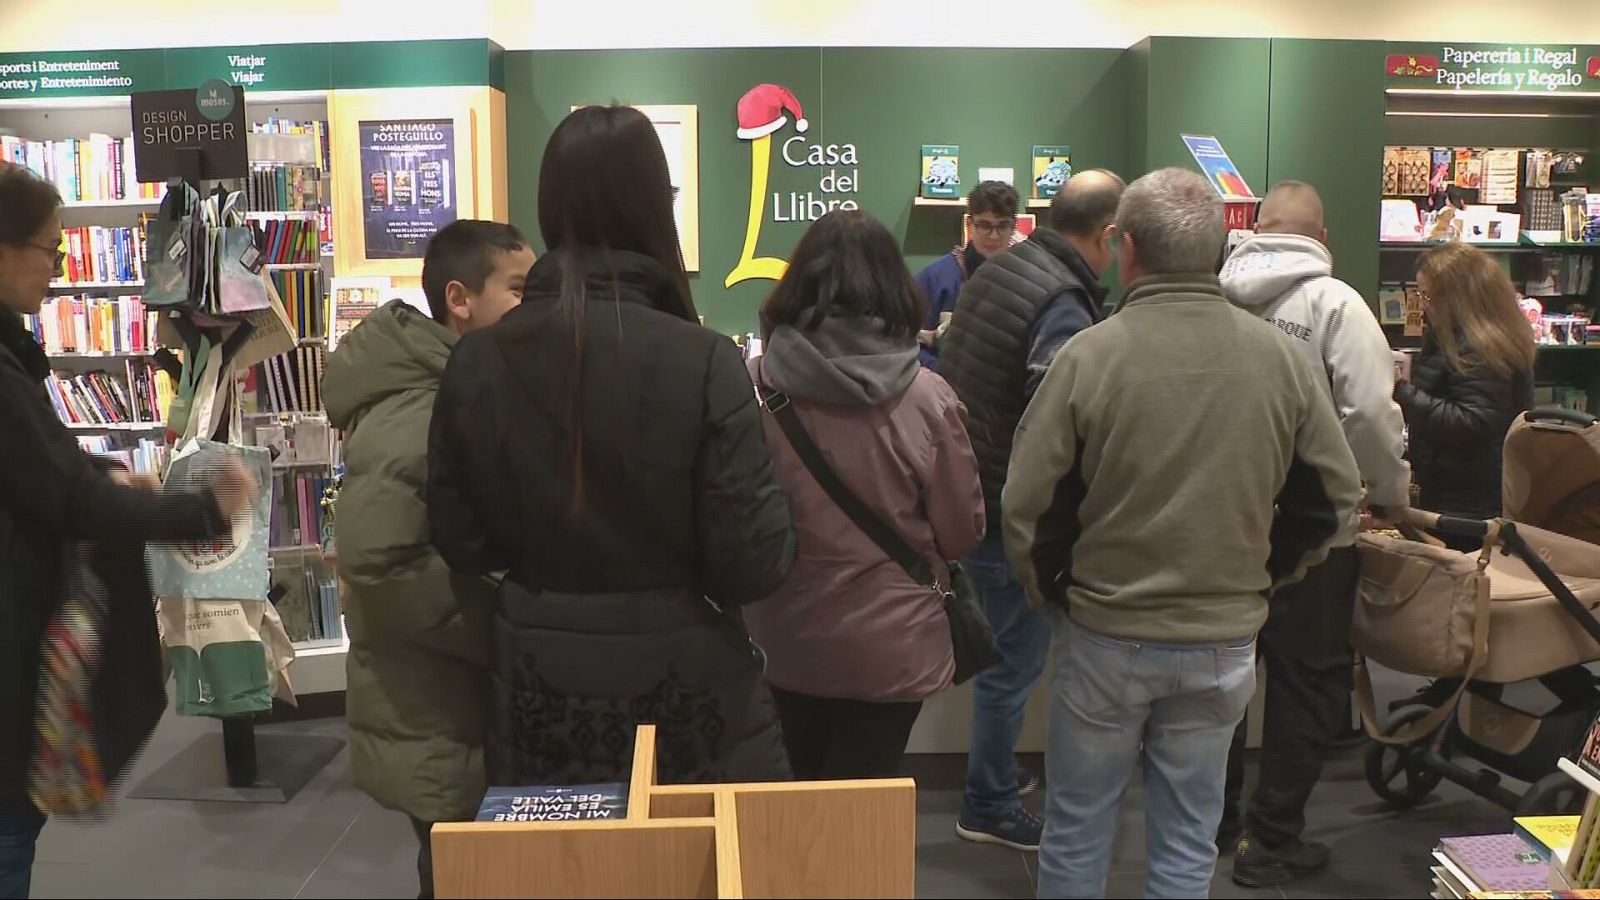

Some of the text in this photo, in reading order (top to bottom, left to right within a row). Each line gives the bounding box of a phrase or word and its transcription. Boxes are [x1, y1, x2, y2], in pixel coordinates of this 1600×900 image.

[227, 54, 267, 69] Viatjar
[1533, 47, 1577, 69] Regal
[38, 60, 120, 73] Entreteniment
[30, 79, 38, 92] y
[40, 75, 133, 89] Entretenimiento
[230, 70, 265, 85] Viajar
[1435, 68, 1582, 90] Papelería y Regalo
[142, 110, 187, 124] DESIGN
[143, 122, 235, 145] SHOPPER
[379, 123, 436, 132] SANTIAGO
[373, 132, 443, 142] POSTEGUILLO
[782, 135, 858, 166] Casa
[820, 169, 858, 193] del
[512, 793, 602, 804] DEL VALLE
[510, 802, 599, 812] ES EMILIA
[494, 809, 611, 821] MI NOMBRE
